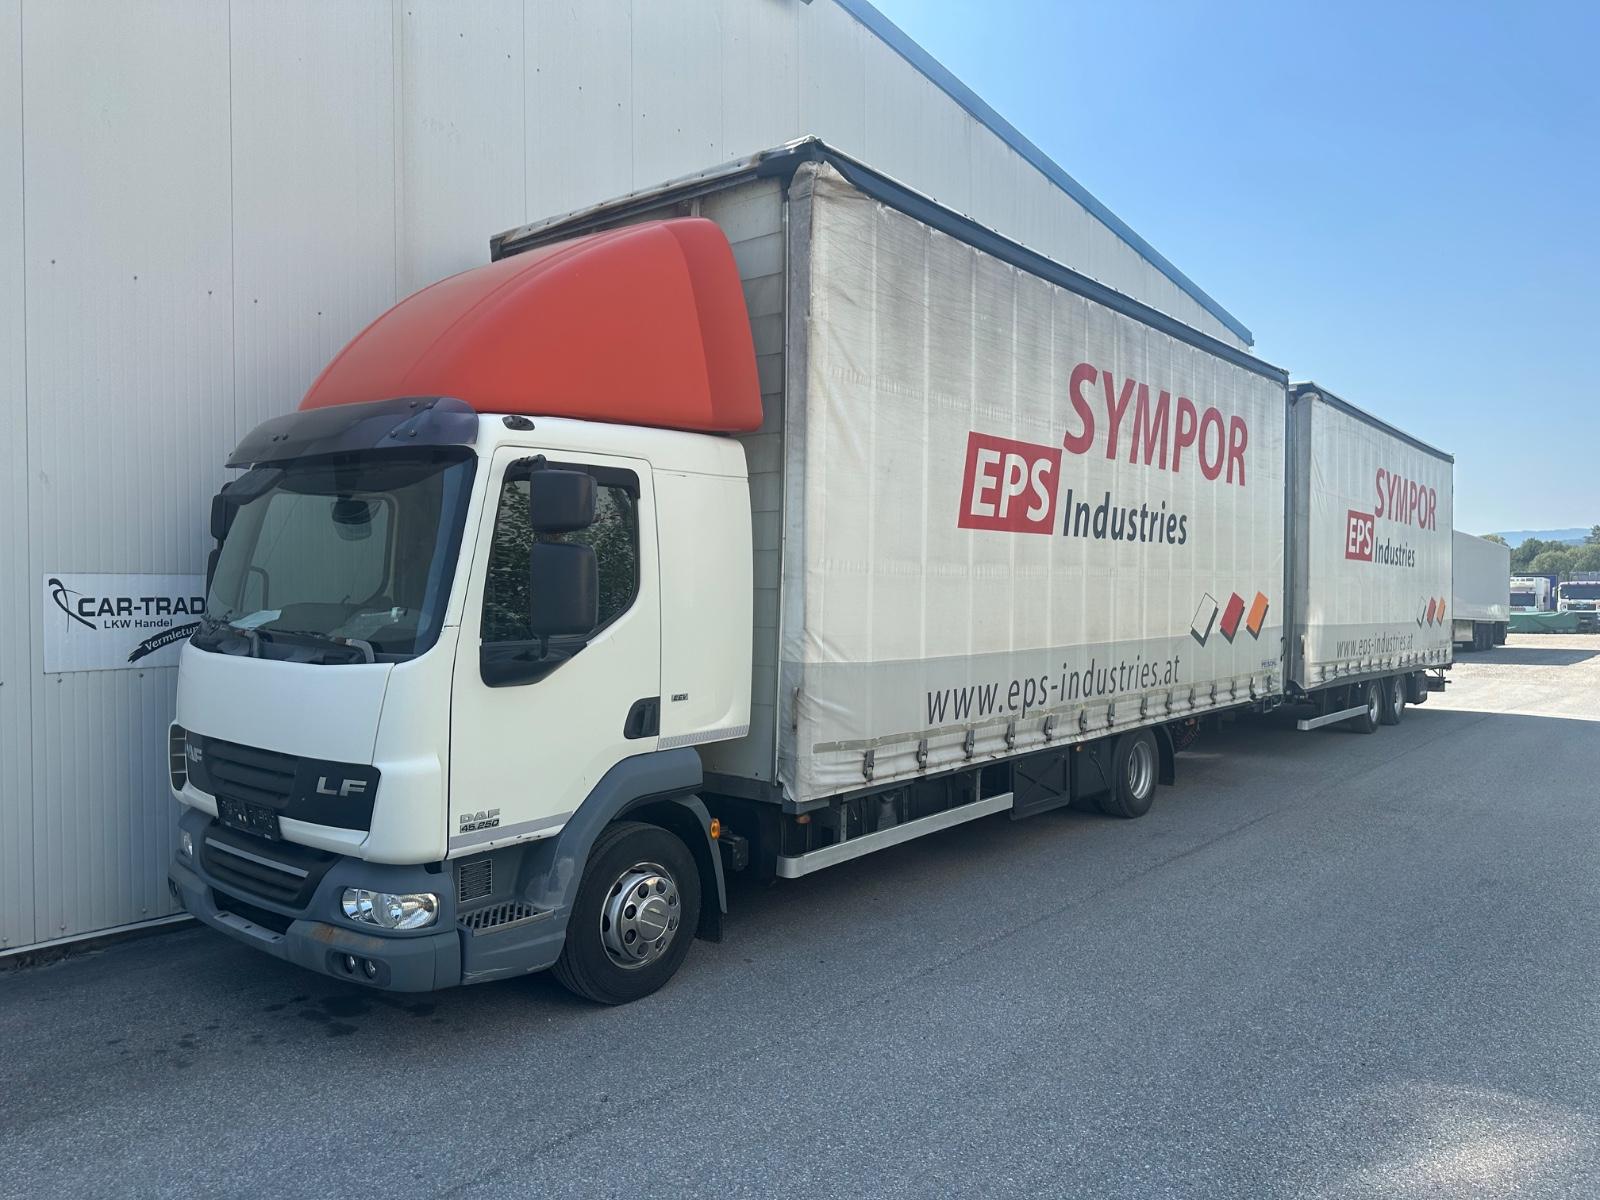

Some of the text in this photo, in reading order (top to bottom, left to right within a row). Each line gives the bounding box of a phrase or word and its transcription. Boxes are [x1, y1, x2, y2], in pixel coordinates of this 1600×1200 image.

[1063, 362, 1248, 487] SYMPOR
[970, 447, 1188, 546] EPS Industries
[1374, 467, 1437, 532] SYMPOR
[1348, 517, 1415, 568] EPS Industries
[103, 618, 173, 629] LKW Handel
[1336, 632, 1414, 659] www.eps-industries.at
[927, 654, 1180, 725] www.eps-industries.at
[316, 776, 367, 796] LF
[460, 808, 500, 824] DAF
